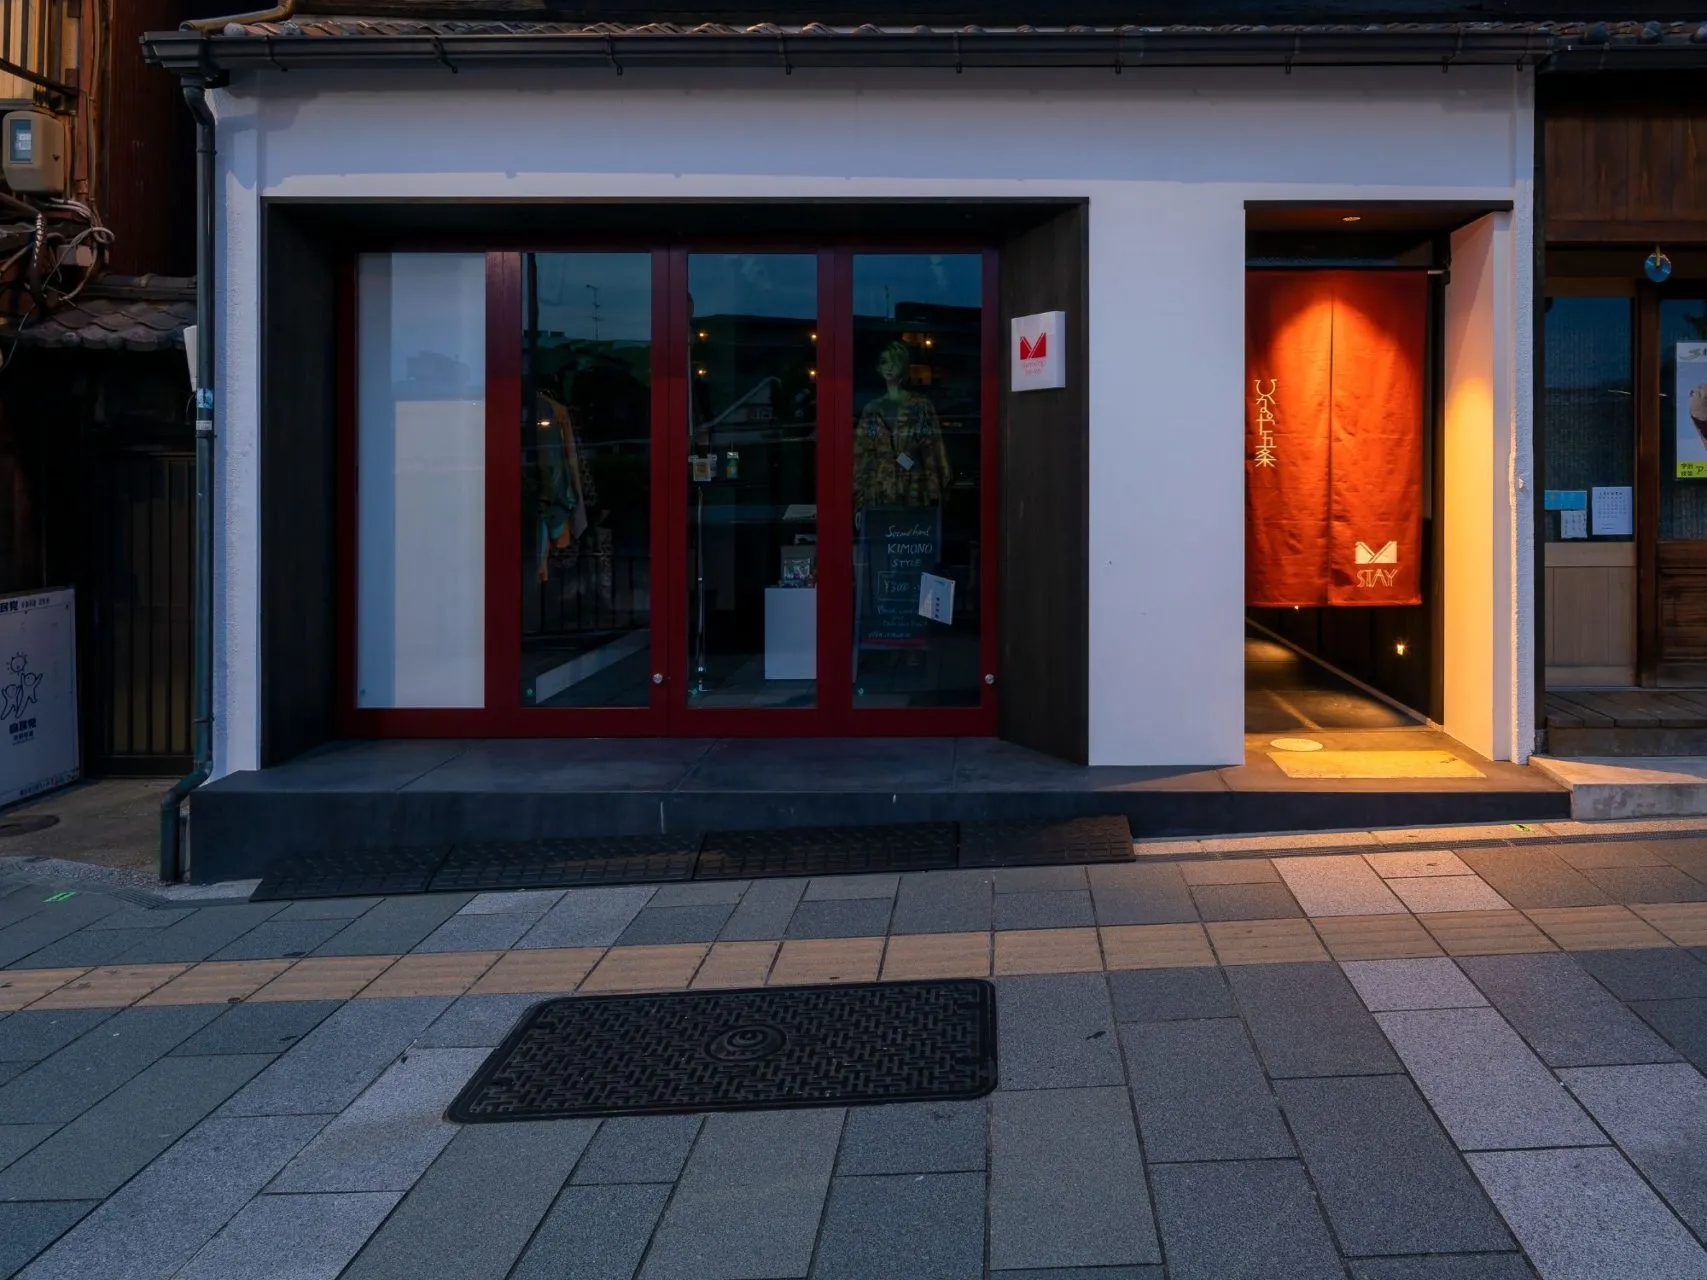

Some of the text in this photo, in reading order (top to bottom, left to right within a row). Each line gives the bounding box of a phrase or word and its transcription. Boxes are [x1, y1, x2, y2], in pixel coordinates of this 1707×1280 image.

[1254, 378, 1277, 468] ひなや五条
[887, 543, 933, 555] KIMONO
[890, 558, 922, 568] STYLE
[1356, 568, 1398, 588] STAY
